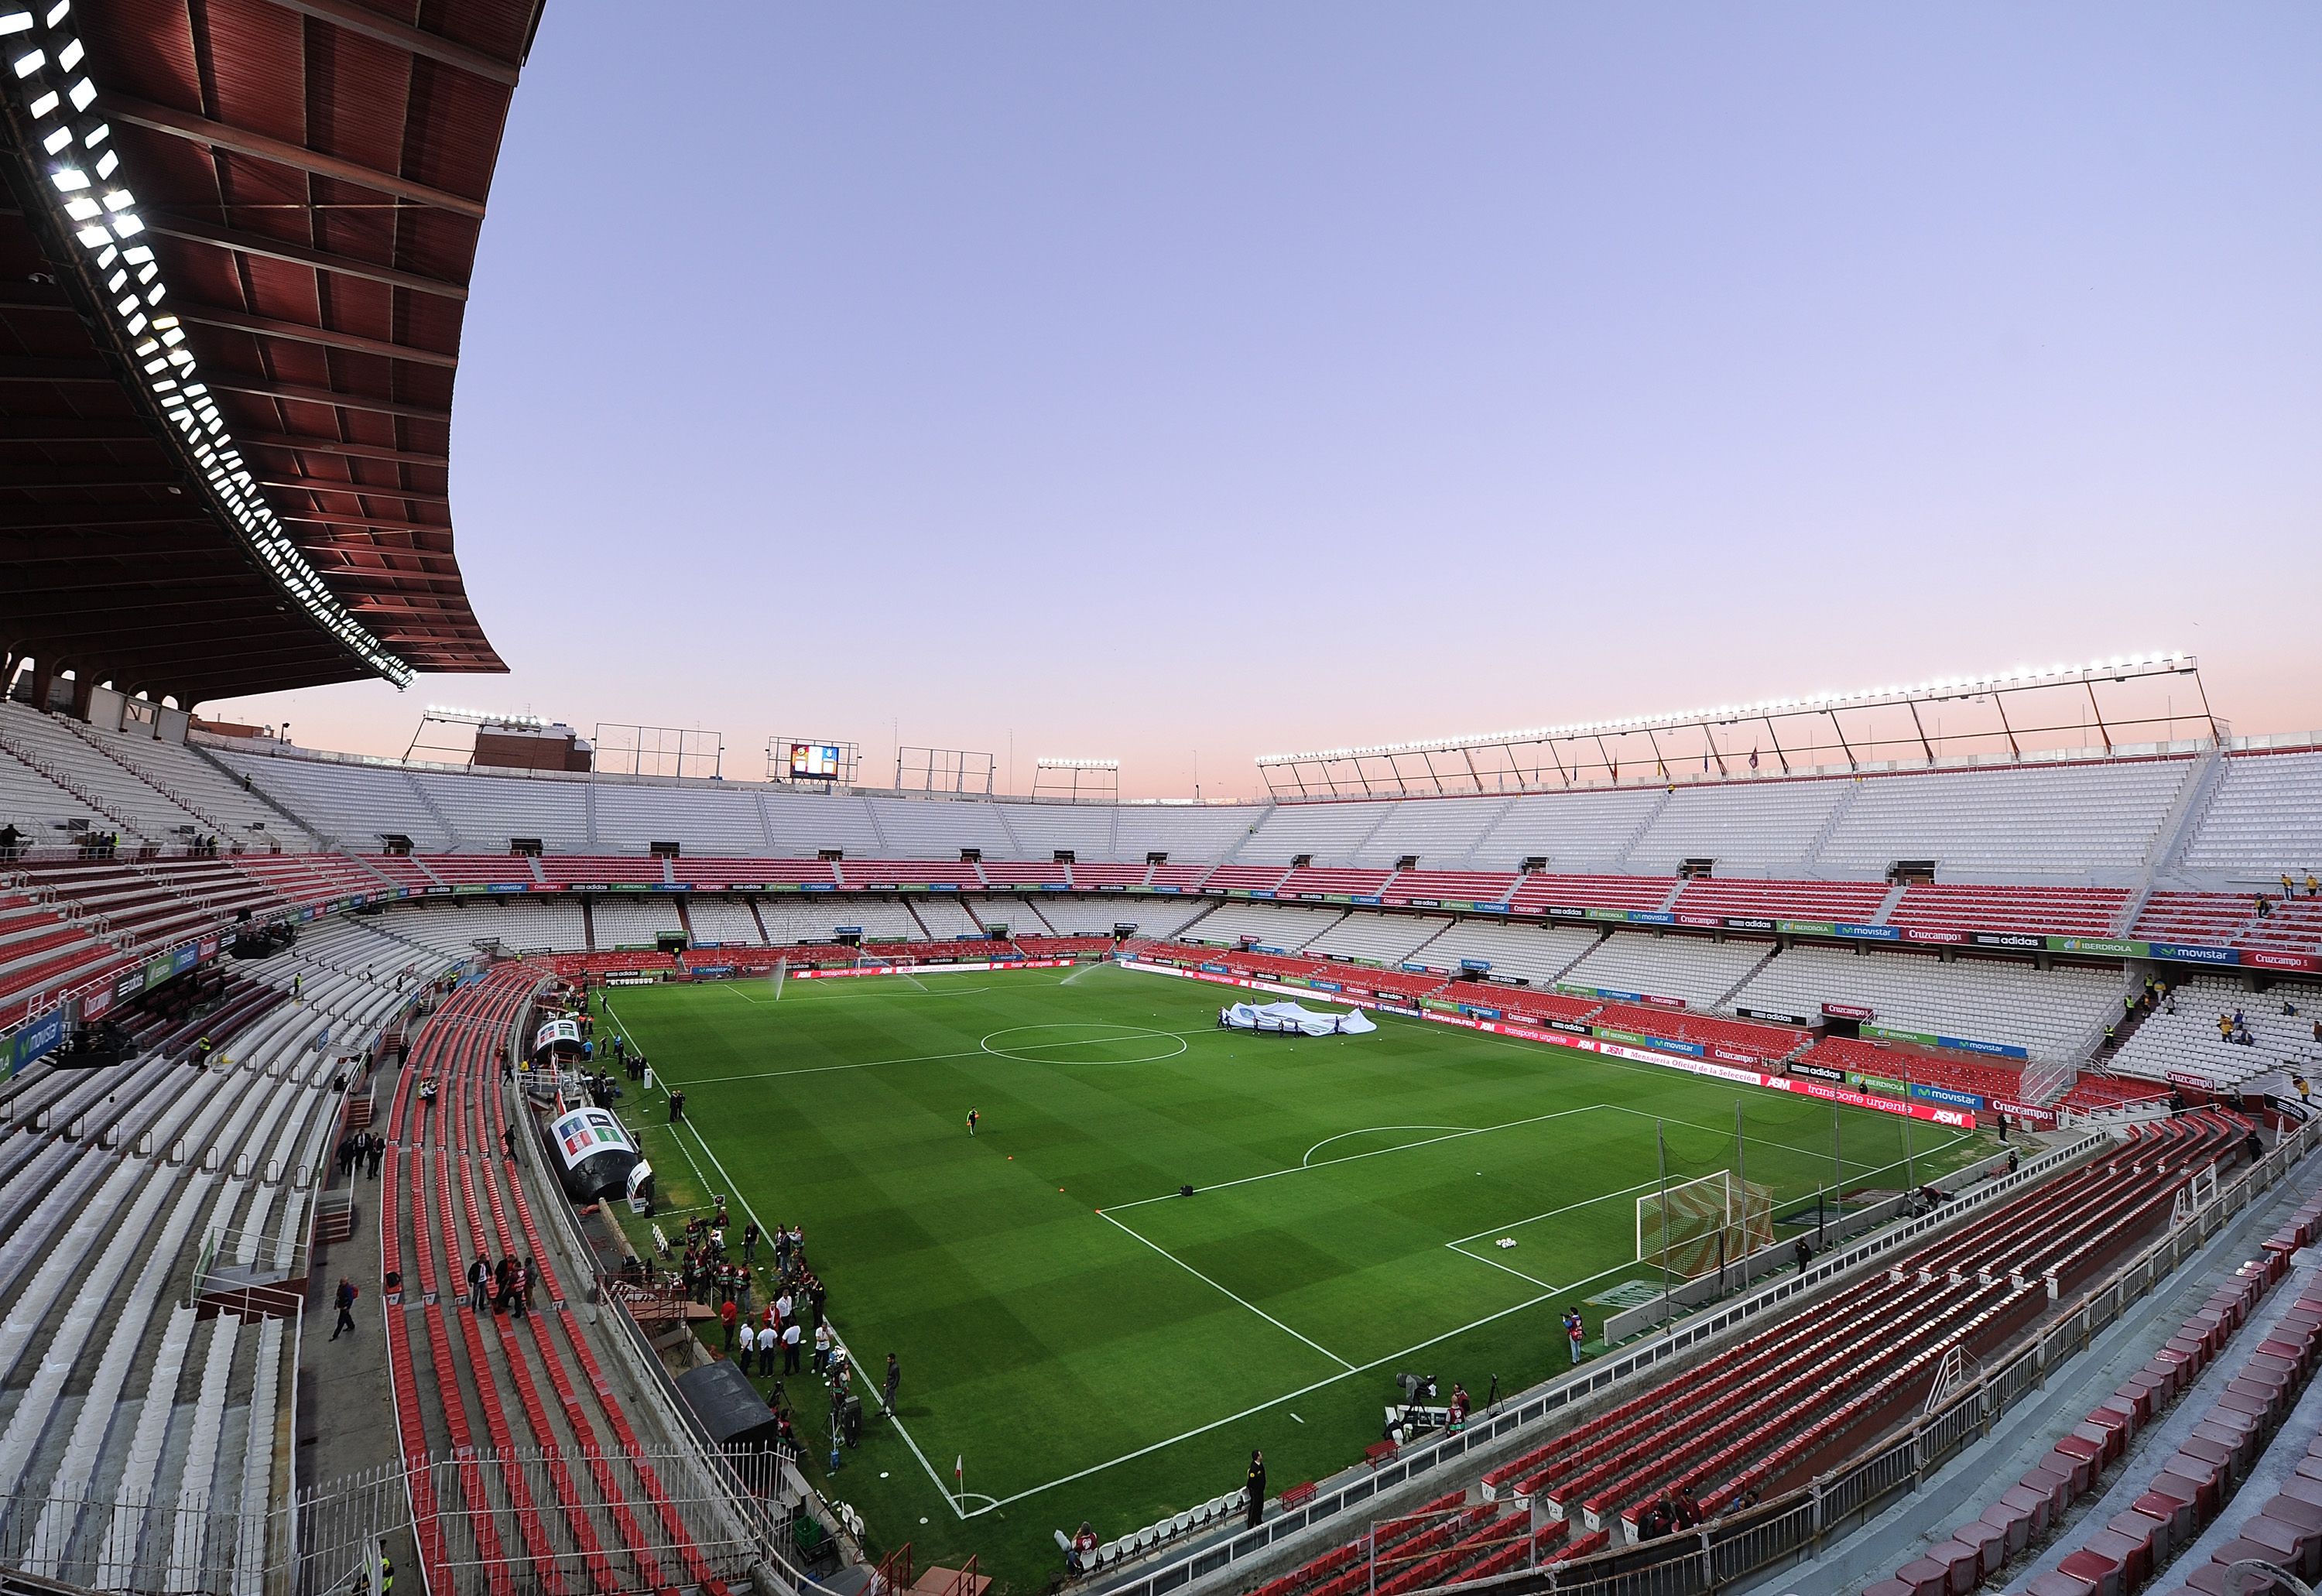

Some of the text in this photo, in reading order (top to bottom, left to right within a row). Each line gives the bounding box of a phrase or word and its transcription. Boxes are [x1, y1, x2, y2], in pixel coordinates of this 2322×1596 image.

[1514, 905, 1539, 913] Cruzcampo
[1680, 915, 1714, 926] Cruzcampo
[1745, 920, 1771, 929] adidas
[1854, 927, 1892, 937] movistar
[1909, 929, 1957, 942] Cruzcampo
[2000, 936, 2039, 947] adidas
[2081, 942, 2132, 953] IBERDROLA
[2177, 948, 2228, 961] movistar
[2255, 954, 2302, 967] Cruzcampo
[1336, 996, 1355, 1005] EUROPEAN
[1651, 996, 1675, 1005] Cruzcampo
[1829, 1005, 1865, 1016] Cruzcampo
[1427, 1012, 1476, 1028] EUROPEAN QUALIFIERS
[1508, 1013, 1534, 1024] Cruzcampo
[1766, 1012, 1793, 1022] adidas
[1564, 1023, 1585, 1033] adidas
[29, 1021, 58, 1053] movistar
[1480, 1022, 1595, 1050] ASM transporte urgente ASM
[1610, 1033, 1637, 1042] IBERDROLA
[1888, 1032, 1918, 1040] IBERDROLA
[1664, 1041, 1694, 1052] movistar
[1969, 1042, 2004, 1053] movistar
[1715, 1049, 1753, 1063] Cruzcampo
[1606, 1046, 1624, 1057] ASM
[1630, 1051, 1670, 1065] Mensajería
[1672, 1060, 1697, 1071] Oficial
[1718, 1069, 1757, 1083] Selección
[1810, 1067, 1841, 1080] adidas
[1865, 1078, 1906, 1092] IBERDROLA
[2166, 1070, 2214, 1090] Cruzcampo
[1765, 1076, 1963, 1126] ASM transporte urgente ASM
[1932, 1091, 1976, 1105] movistar
[1992, 1100, 2049, 1120] Cruzcampo
